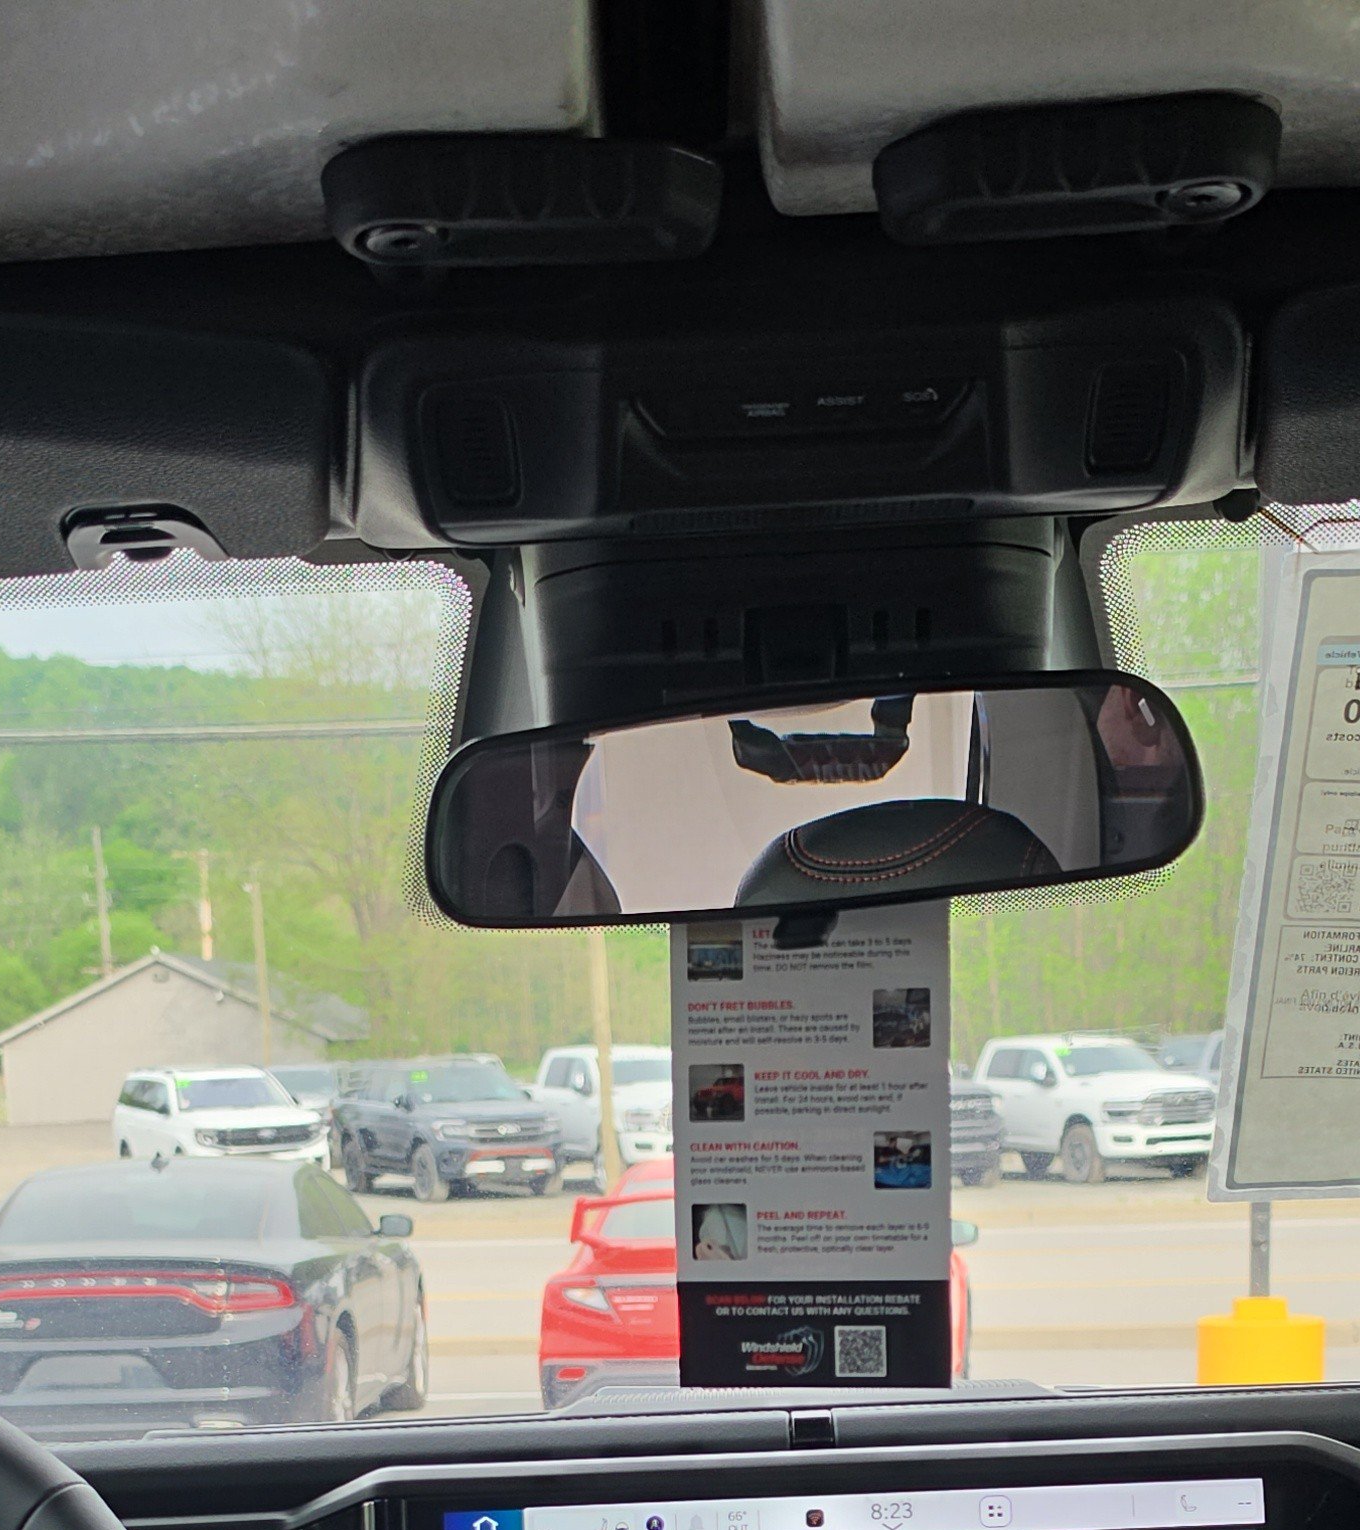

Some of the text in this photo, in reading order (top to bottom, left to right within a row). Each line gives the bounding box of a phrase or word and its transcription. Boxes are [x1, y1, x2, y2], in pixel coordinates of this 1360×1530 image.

[817, 396, 864, 406] ASSIST
[754, 1072, 779, 1081] KEEP
[794, 1071, 821, 1080] COOL
[824, 1071, 845, 1079] AND
[768, 1296, 921, 1304] FOR YOUR INSTALLATION REBATE
[716, 1308, 729, 1316] OR
[732, 1307, 744, 1316] TO
[746, 1307, 789, 1316] CONTACT
[792, 1307, 804, 1315] US
[807, 1307, 830, 1315] WITH
[833, 1307, 852, 1315] ANY
[742, 1342, 803, 1353] Windshield
[871, 1503, 913, 1520] 8:23
